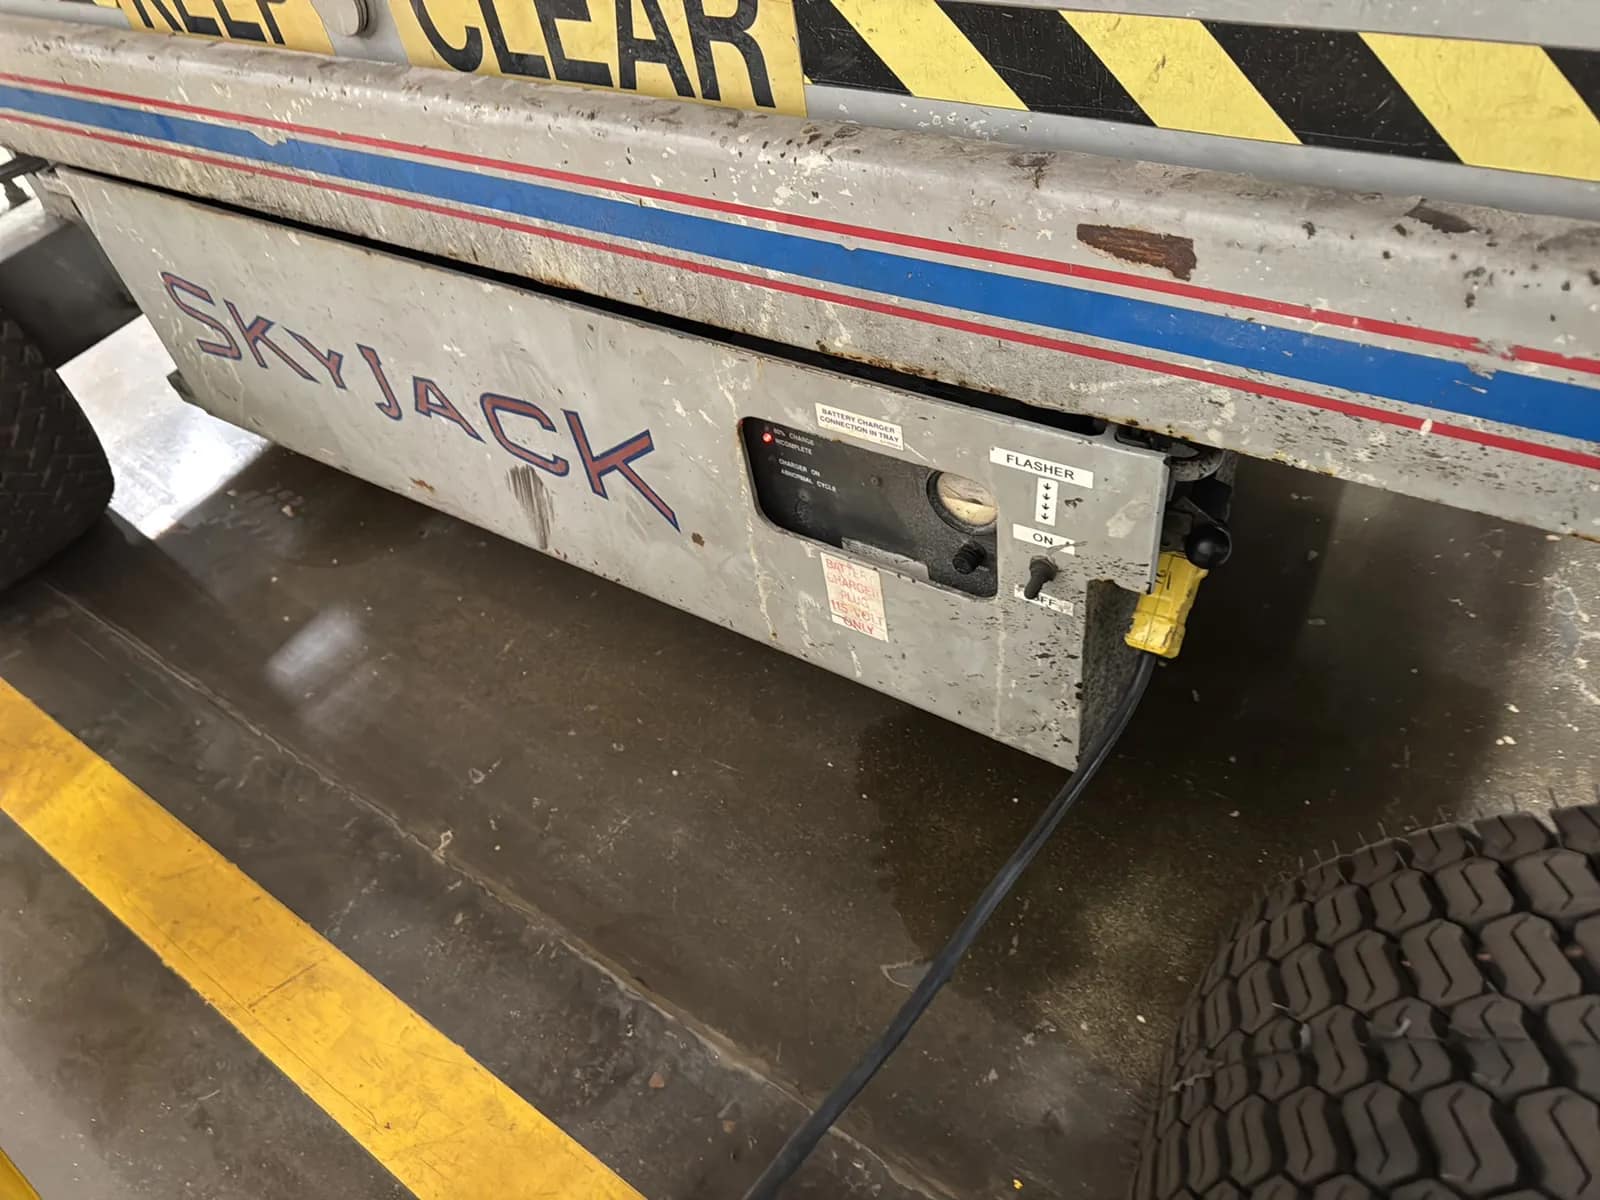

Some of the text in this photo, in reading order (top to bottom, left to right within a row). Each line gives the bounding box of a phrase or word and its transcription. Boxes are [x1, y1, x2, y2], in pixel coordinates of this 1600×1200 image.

[412, 0, 776, 108] CLEAR
[161, 271, 682, 532] SKYJACK
[819, 415, 868, 435] CONNECTION
[879, 431, 899, 442] TRAY
[821, 408, 895, 434] BATTERY CHARGER
[778, 458, 821, 478] CHARGER ON
[1006, 454, 1074, 480] FLASHER
[816, 480, 837, 492] CYCLE
[1032, 532, 1053, 546] ON
[843, 616, 874, 635] ONLY
